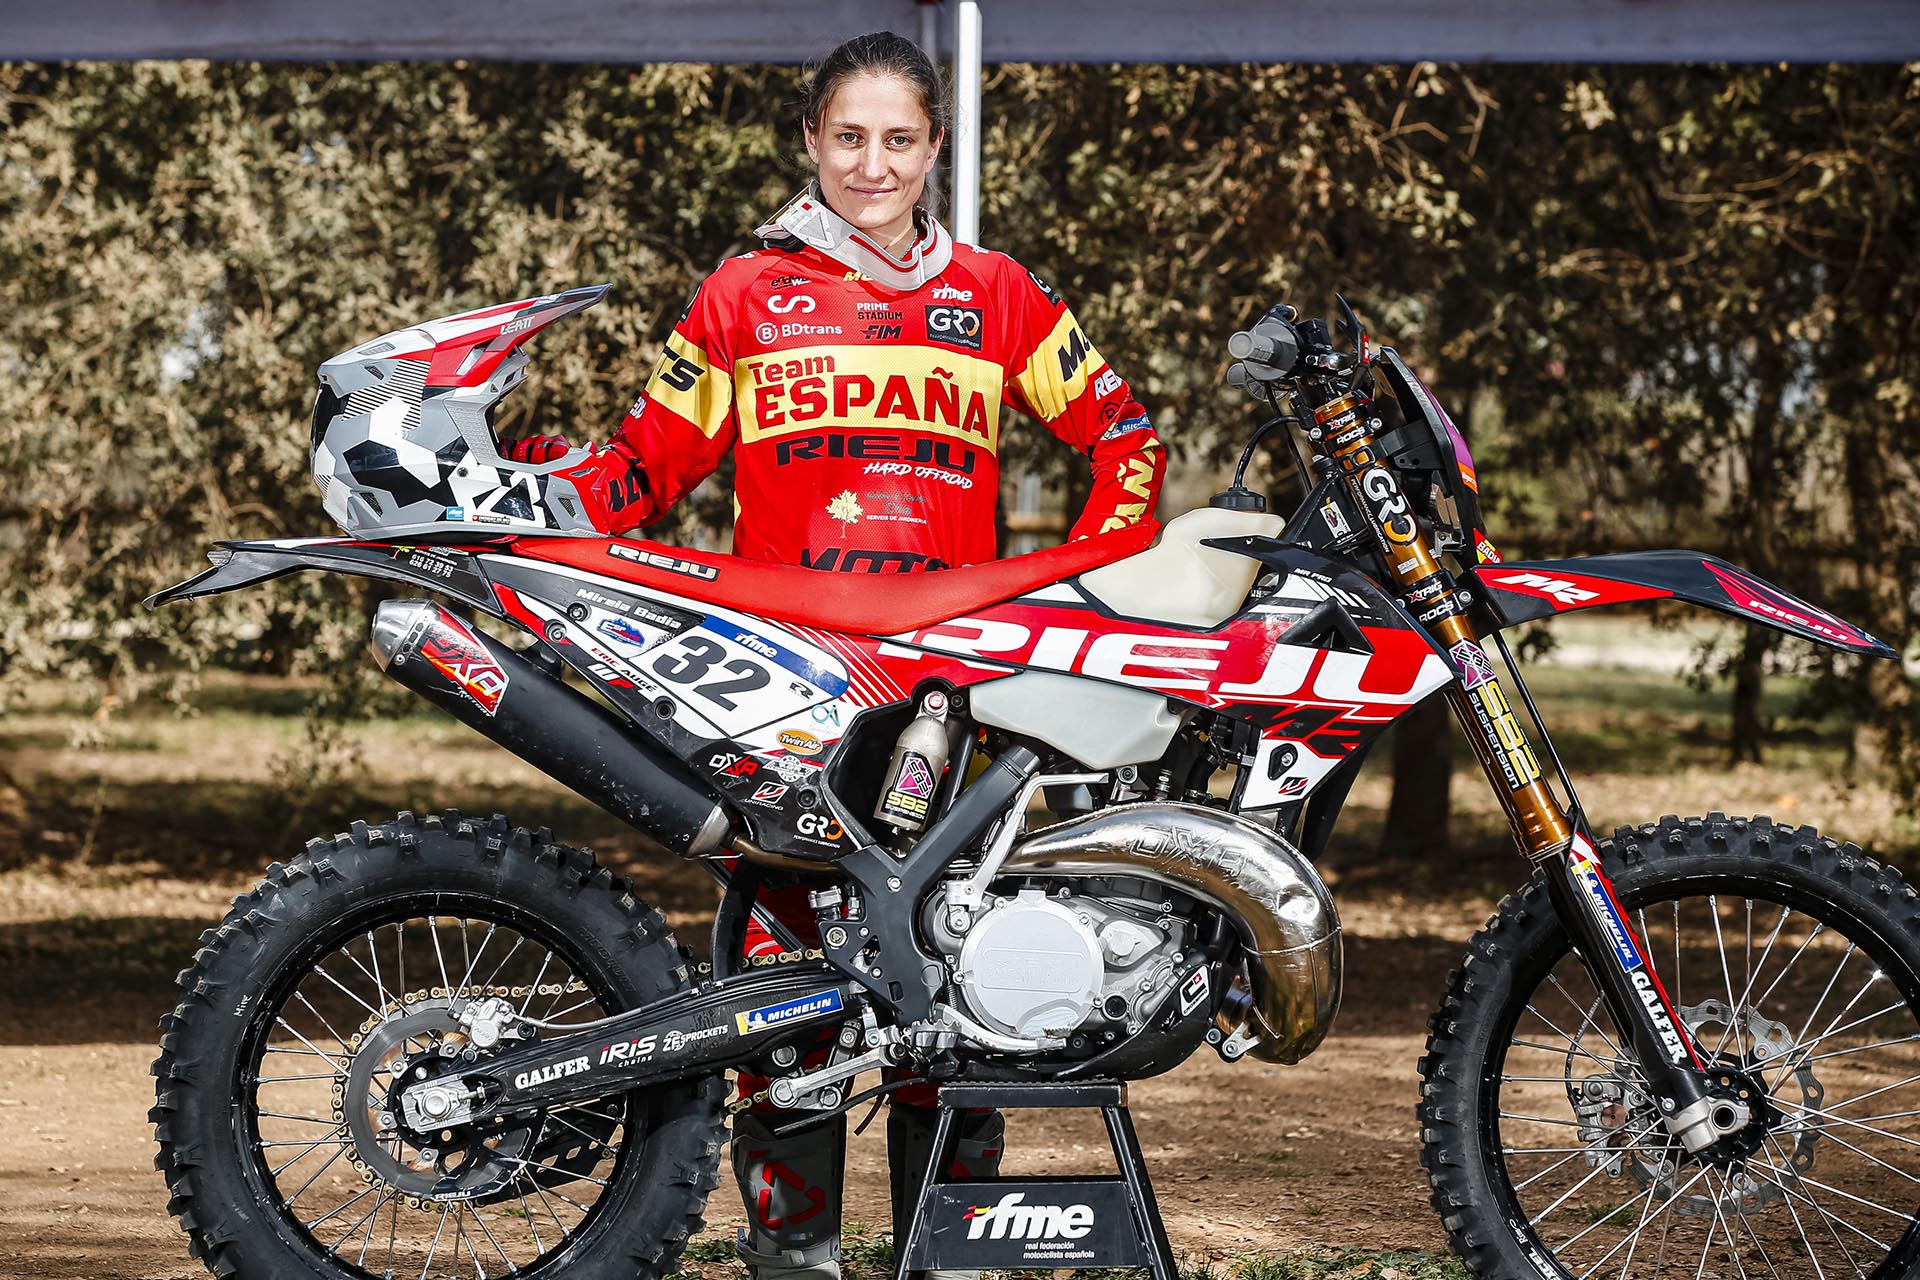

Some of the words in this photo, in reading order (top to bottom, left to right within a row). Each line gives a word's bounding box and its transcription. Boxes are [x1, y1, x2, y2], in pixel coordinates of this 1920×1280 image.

[857, 302, 889, 311] PRIME
[857, 312, 902, 320] STADIUM
[782, 323, 843, 337] BDtrans
[861, 325, 902, 339] FIM
[929, 308, 980, 337] GRO
[748, 355, 835, 385] Team
[755, 366, 989, 440] ESPAÑA
[1326, 411, 1356, 430] XTRIG
[1337, 426, 1366, 444] ROCS
[776, 434, 976, 475] RIEJU
[863, 462, 912, 476] HARD
[914, 465, 973, 490] OFFROAD
[609, 544, 717, 579] RIEJU
[1294, 567, 1311, 577] MR
[1311, 572, 1333, 584] PRO
[1405, 580, 1442, 604] XTRIG
[633, 606, 682, 629] Badia
[1419, 600, 1455, 623] ROCS
[1747, 599, 1849, 641] RIEJU
[591, 647, 620, 667] ERIC
[734, 631, 778, 658] rfme
[653, 635, 771, 712] 32
[877, 617, 1453, 705] RIEJU
[780, 733, 803, 748] Twin
[802, 738, 820, 750] Air
[1468, 692, 1520, 790] SUSPENSION
[1477, 681, 1541, 785] SB2
[886, 791, 928, 815] SB2
[796, 813, 844, 840] GRO
[1592, 892, 1634, 960] MICHELIN
[767, 997, 832, 1022] MICHELIN
[1631, 970, 1688, 1065] GALFER
[681, 1024, 729, 1043] SPROCKETS
[514, 1056, 591, 1090] GALFER
[618, 1054, 653, 1068] chains
[965, 1192, 1095, 1240] rfme
[1023, 1251, 1063, 1259] motociclista
[1064, 1250, 1095, 1260] española
[1025, 1242, 1038, 1250] real
[1039, 1241, 1075, 1251] federación
